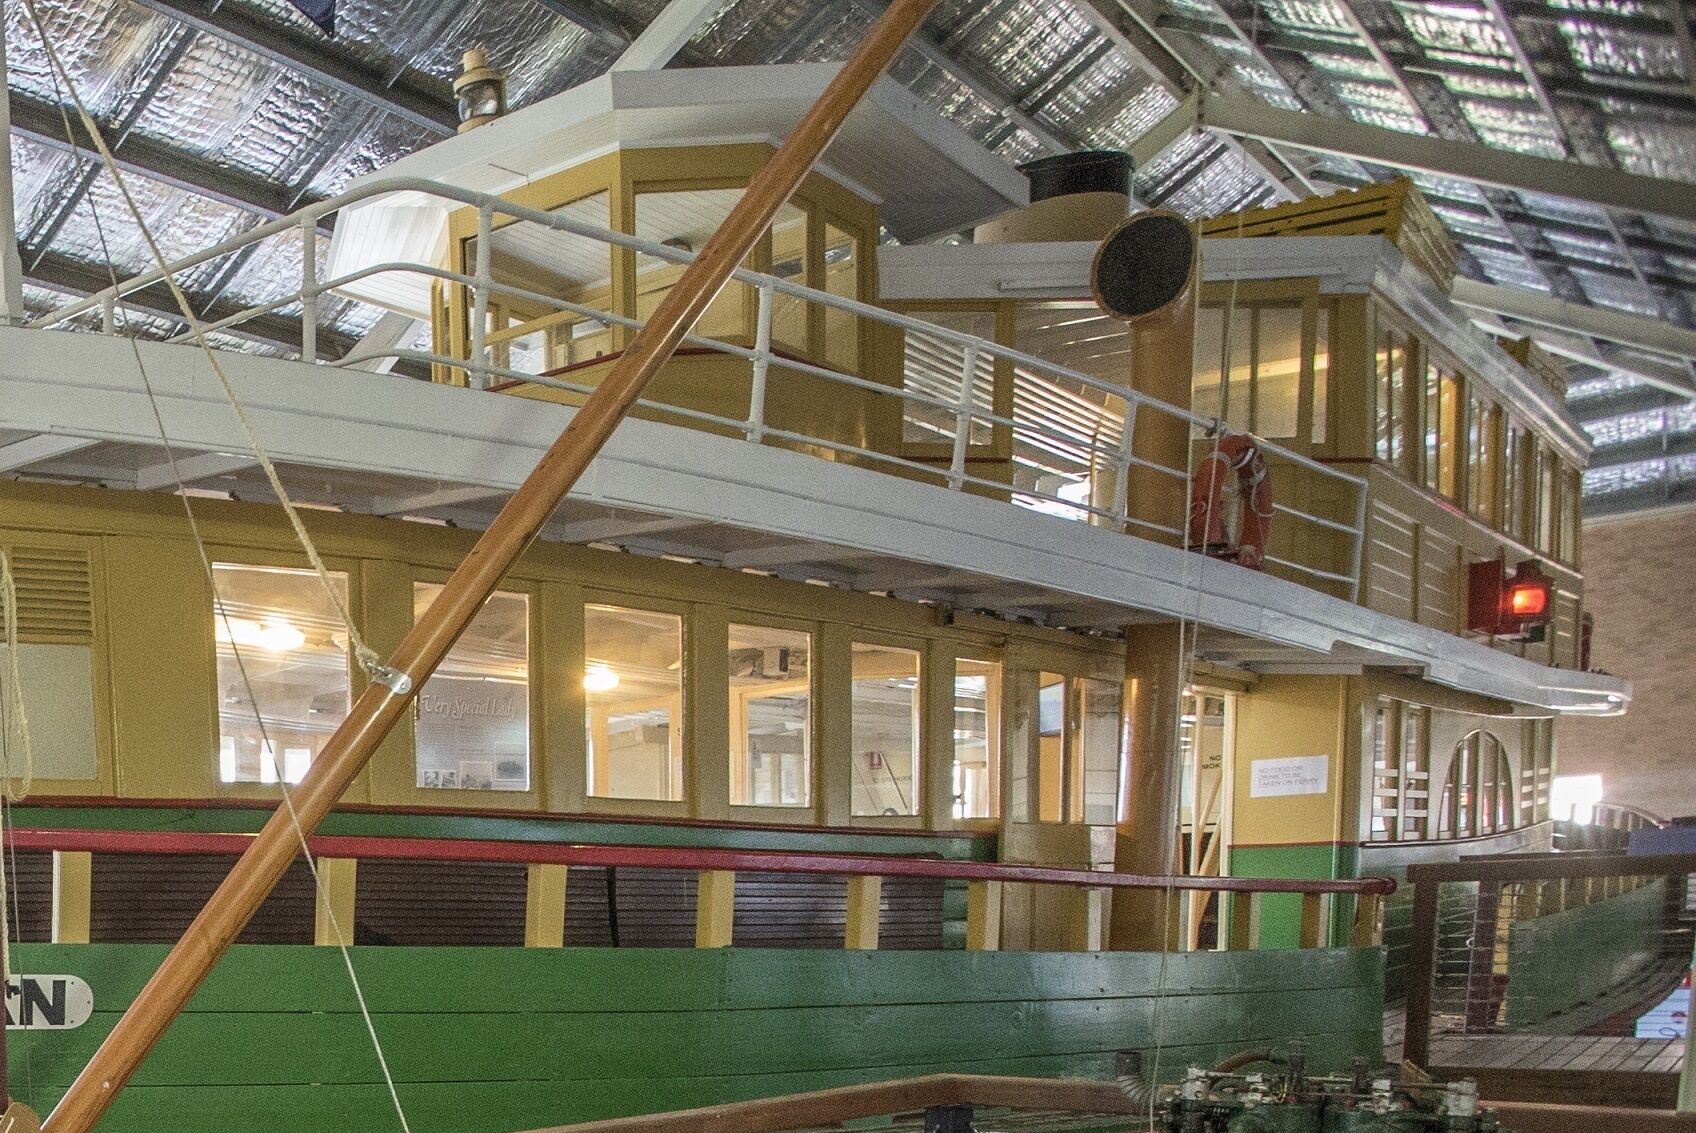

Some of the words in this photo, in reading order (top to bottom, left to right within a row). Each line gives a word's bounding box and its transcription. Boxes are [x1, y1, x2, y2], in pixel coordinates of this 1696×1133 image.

[421, 695, 450, 719] Very
[452, 696, 490, 719] Special
[491, 698, 516, 720] Lady
